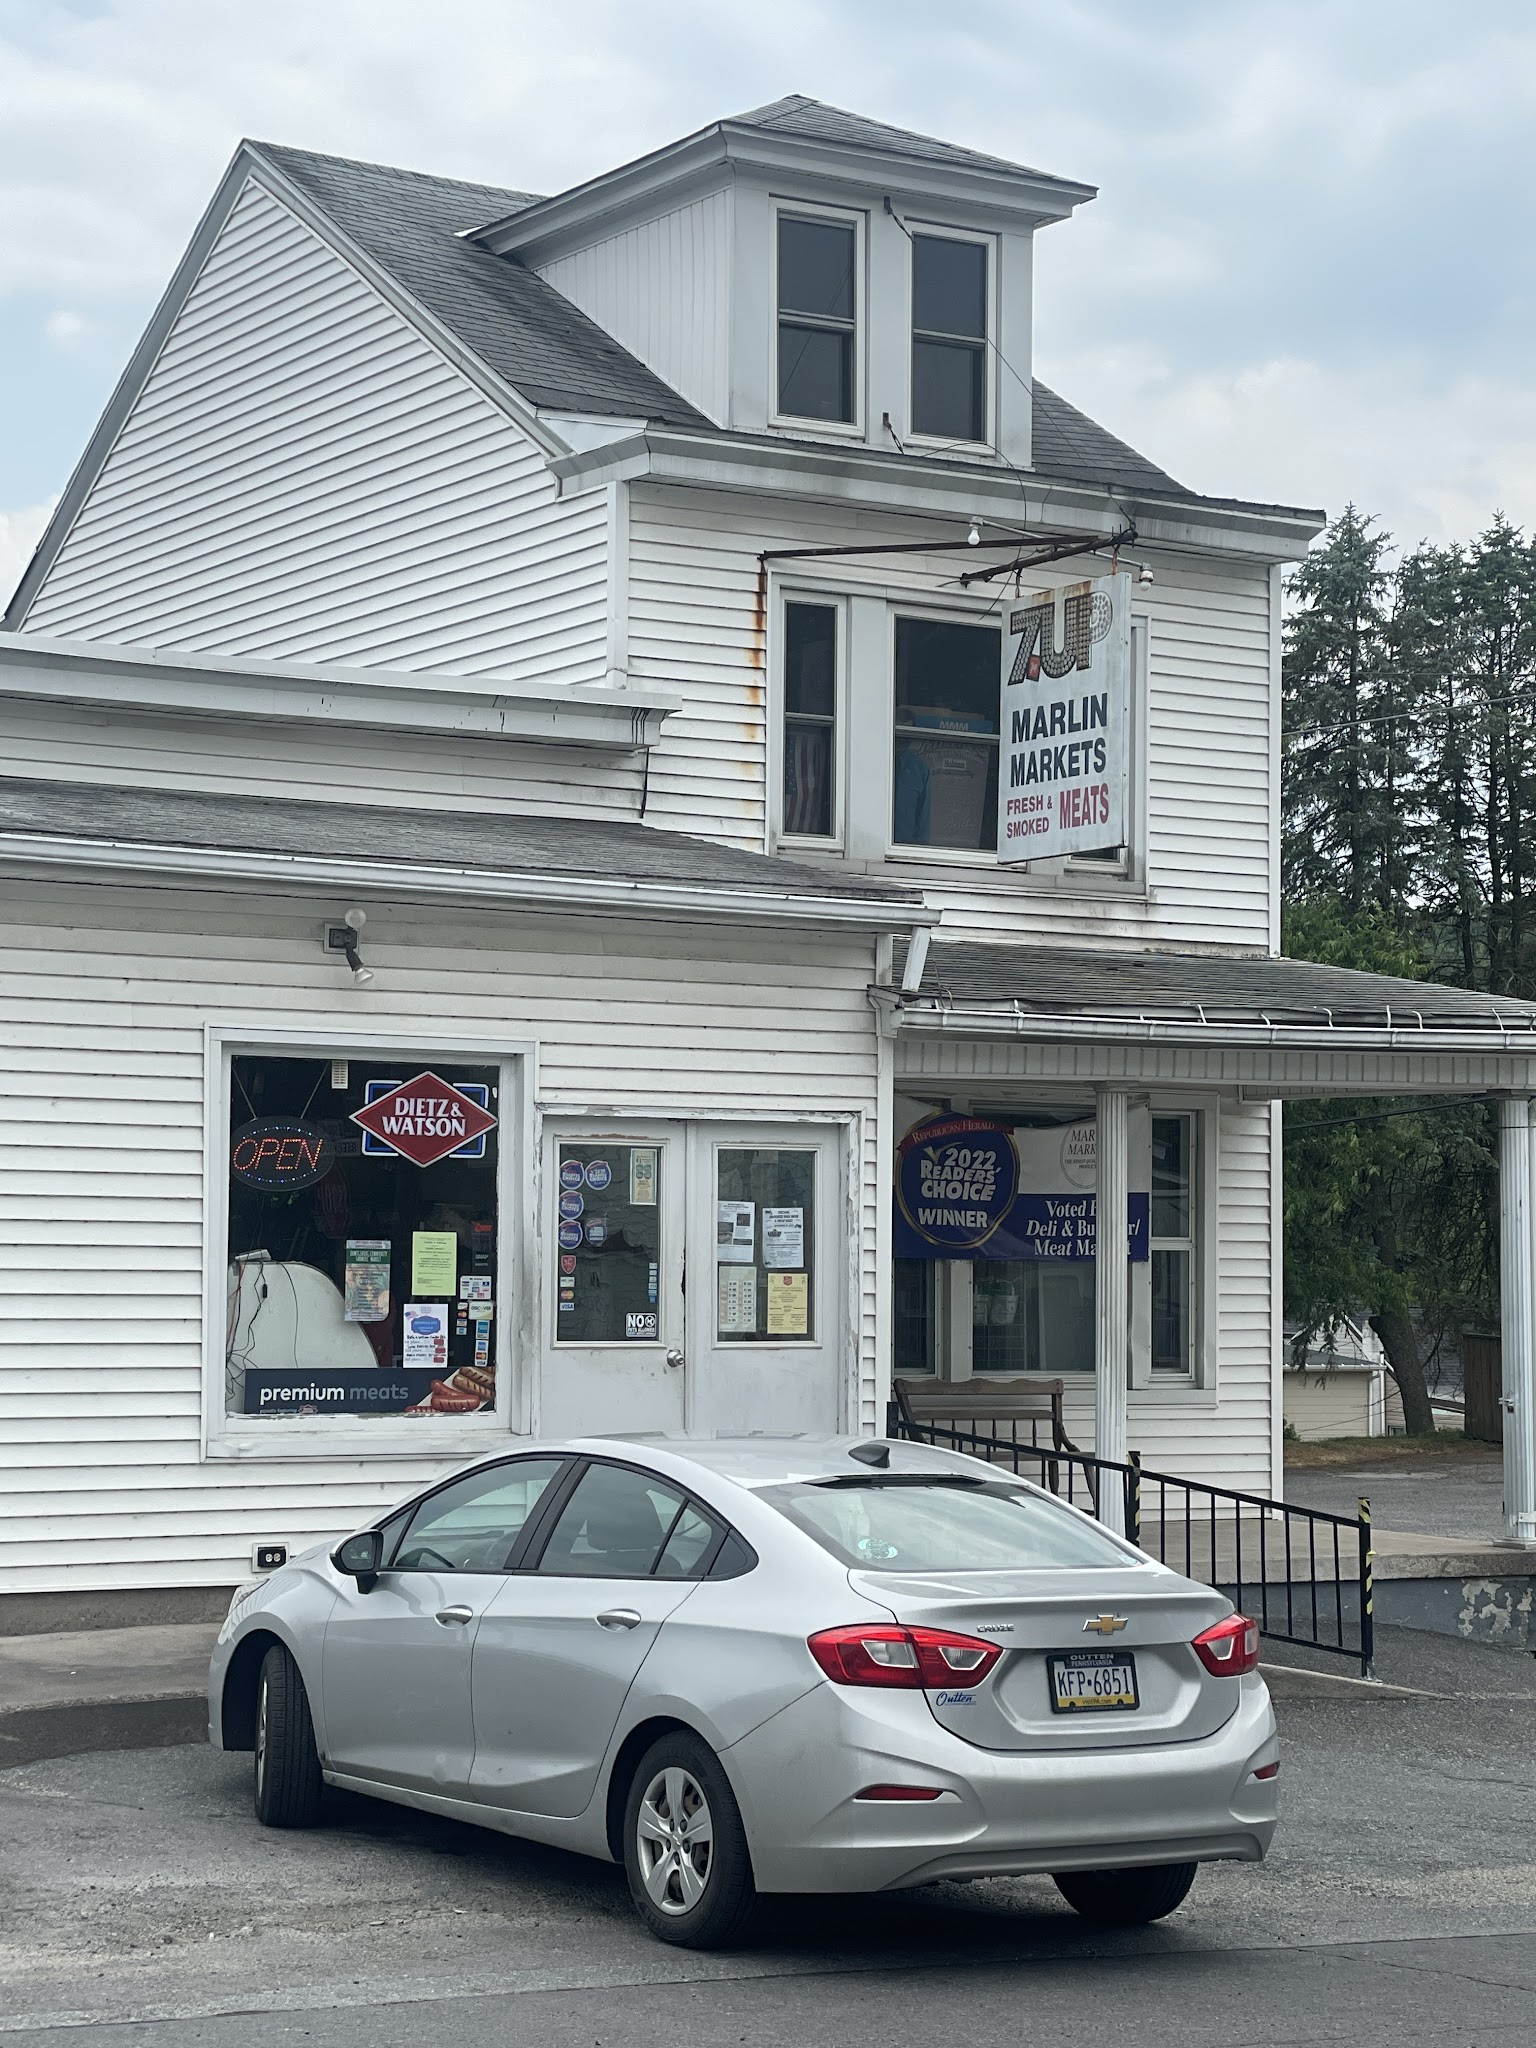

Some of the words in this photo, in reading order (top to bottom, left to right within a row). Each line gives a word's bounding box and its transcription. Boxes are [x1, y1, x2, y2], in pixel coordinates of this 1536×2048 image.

[1011, 693, 1108, 744] MARLIN
[1010, 737, 1107, 787] MARKETS
[1007, 795, 1044, 816] FRESH
[1047, 796, 1053, 809] &
[1059, 783, 1109, 830] MEATS
[1007, 816, 1050, 839] SMOKED
[382, 1116, 466, 1137] WATSON
[911, 1123, 961, 1144] REPUBLICAN
[962, 1119, 996, 1131] HERALD
[1071, 1129, 1096, 1142] MAR
[233, 1138, 323, 1170] OPEN
[945, 1147, 997, 1169] 2022
[1067, 1143, 1097, 1155] MARK
[921, 1180, 997, 1201] CHOICE
[917, 1207, 988, 1228] WINNER
[1045, 1199, 1087, 1217] Voted
[1025, 1219, 1058, 1237] Deli
[1061, 1219, 1074, 1237] &
[1034, 1238, 1073, 1256] Meat
[628, 1314, 645, 1327] NO
[260, 1383, 345, 1405] premium
[350, 1384, 409, 1400] meats
[977, 1624, 1015, 1633] CRUZE
[1070, 1653, 1114, 1661] OUTTEN
[936, 1691, 975, 1706] Outten
